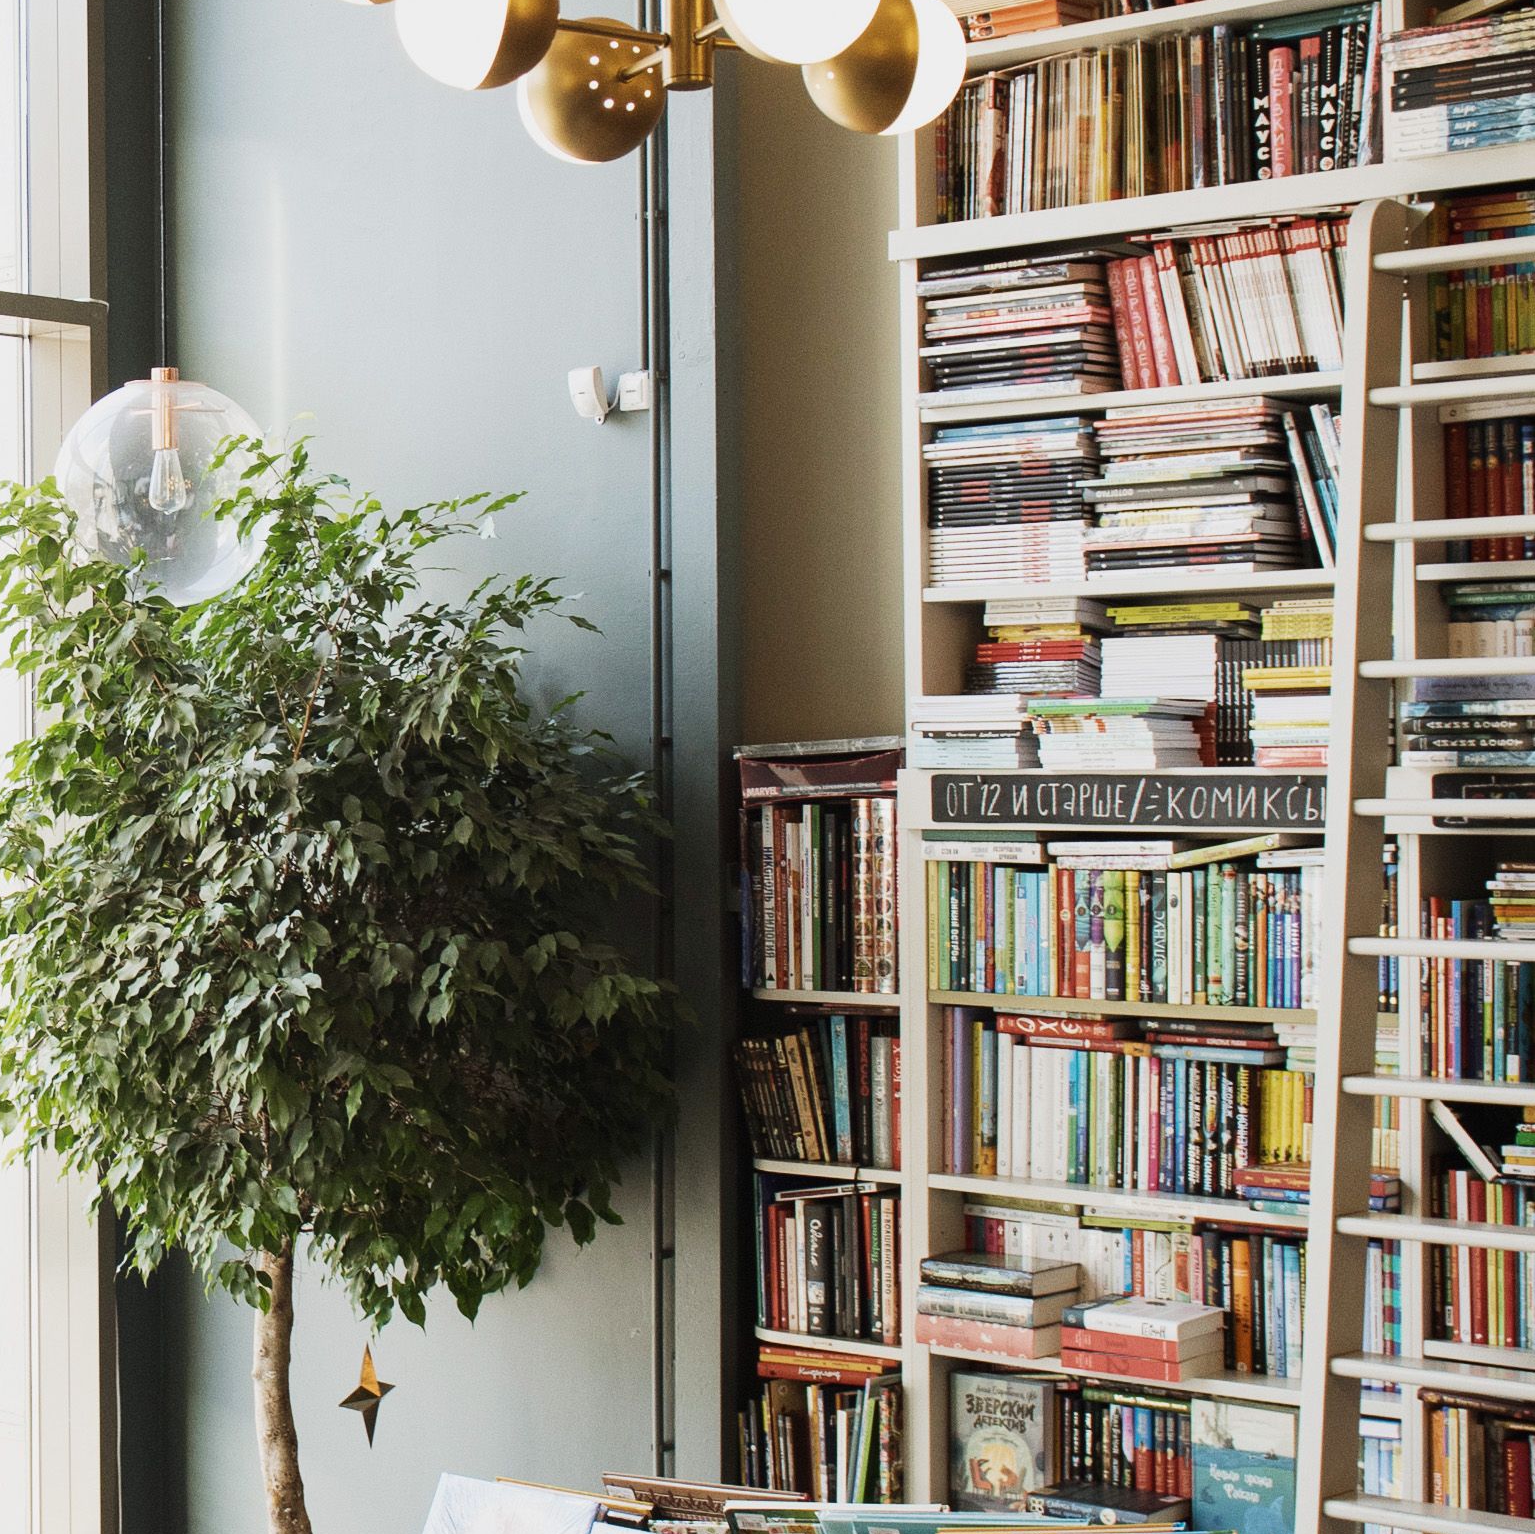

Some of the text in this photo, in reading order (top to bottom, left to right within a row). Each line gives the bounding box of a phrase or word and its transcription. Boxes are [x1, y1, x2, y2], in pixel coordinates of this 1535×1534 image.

[1319, 83, 1338, 150] МАУС
[1252, 96, 1272, 170] МАУС
[1473, 719, 1519, 730] РОБОТ
[1479, 738, 1524, 748] РОБОТ
[945, 780, 974, 818] ОТ
[1012, 783, 1029, 816] И
[1166, 783, 1327, 824] КОМИКСЫ
[973, 1413, 1028, 1434] ДЕТЕКТИВ
